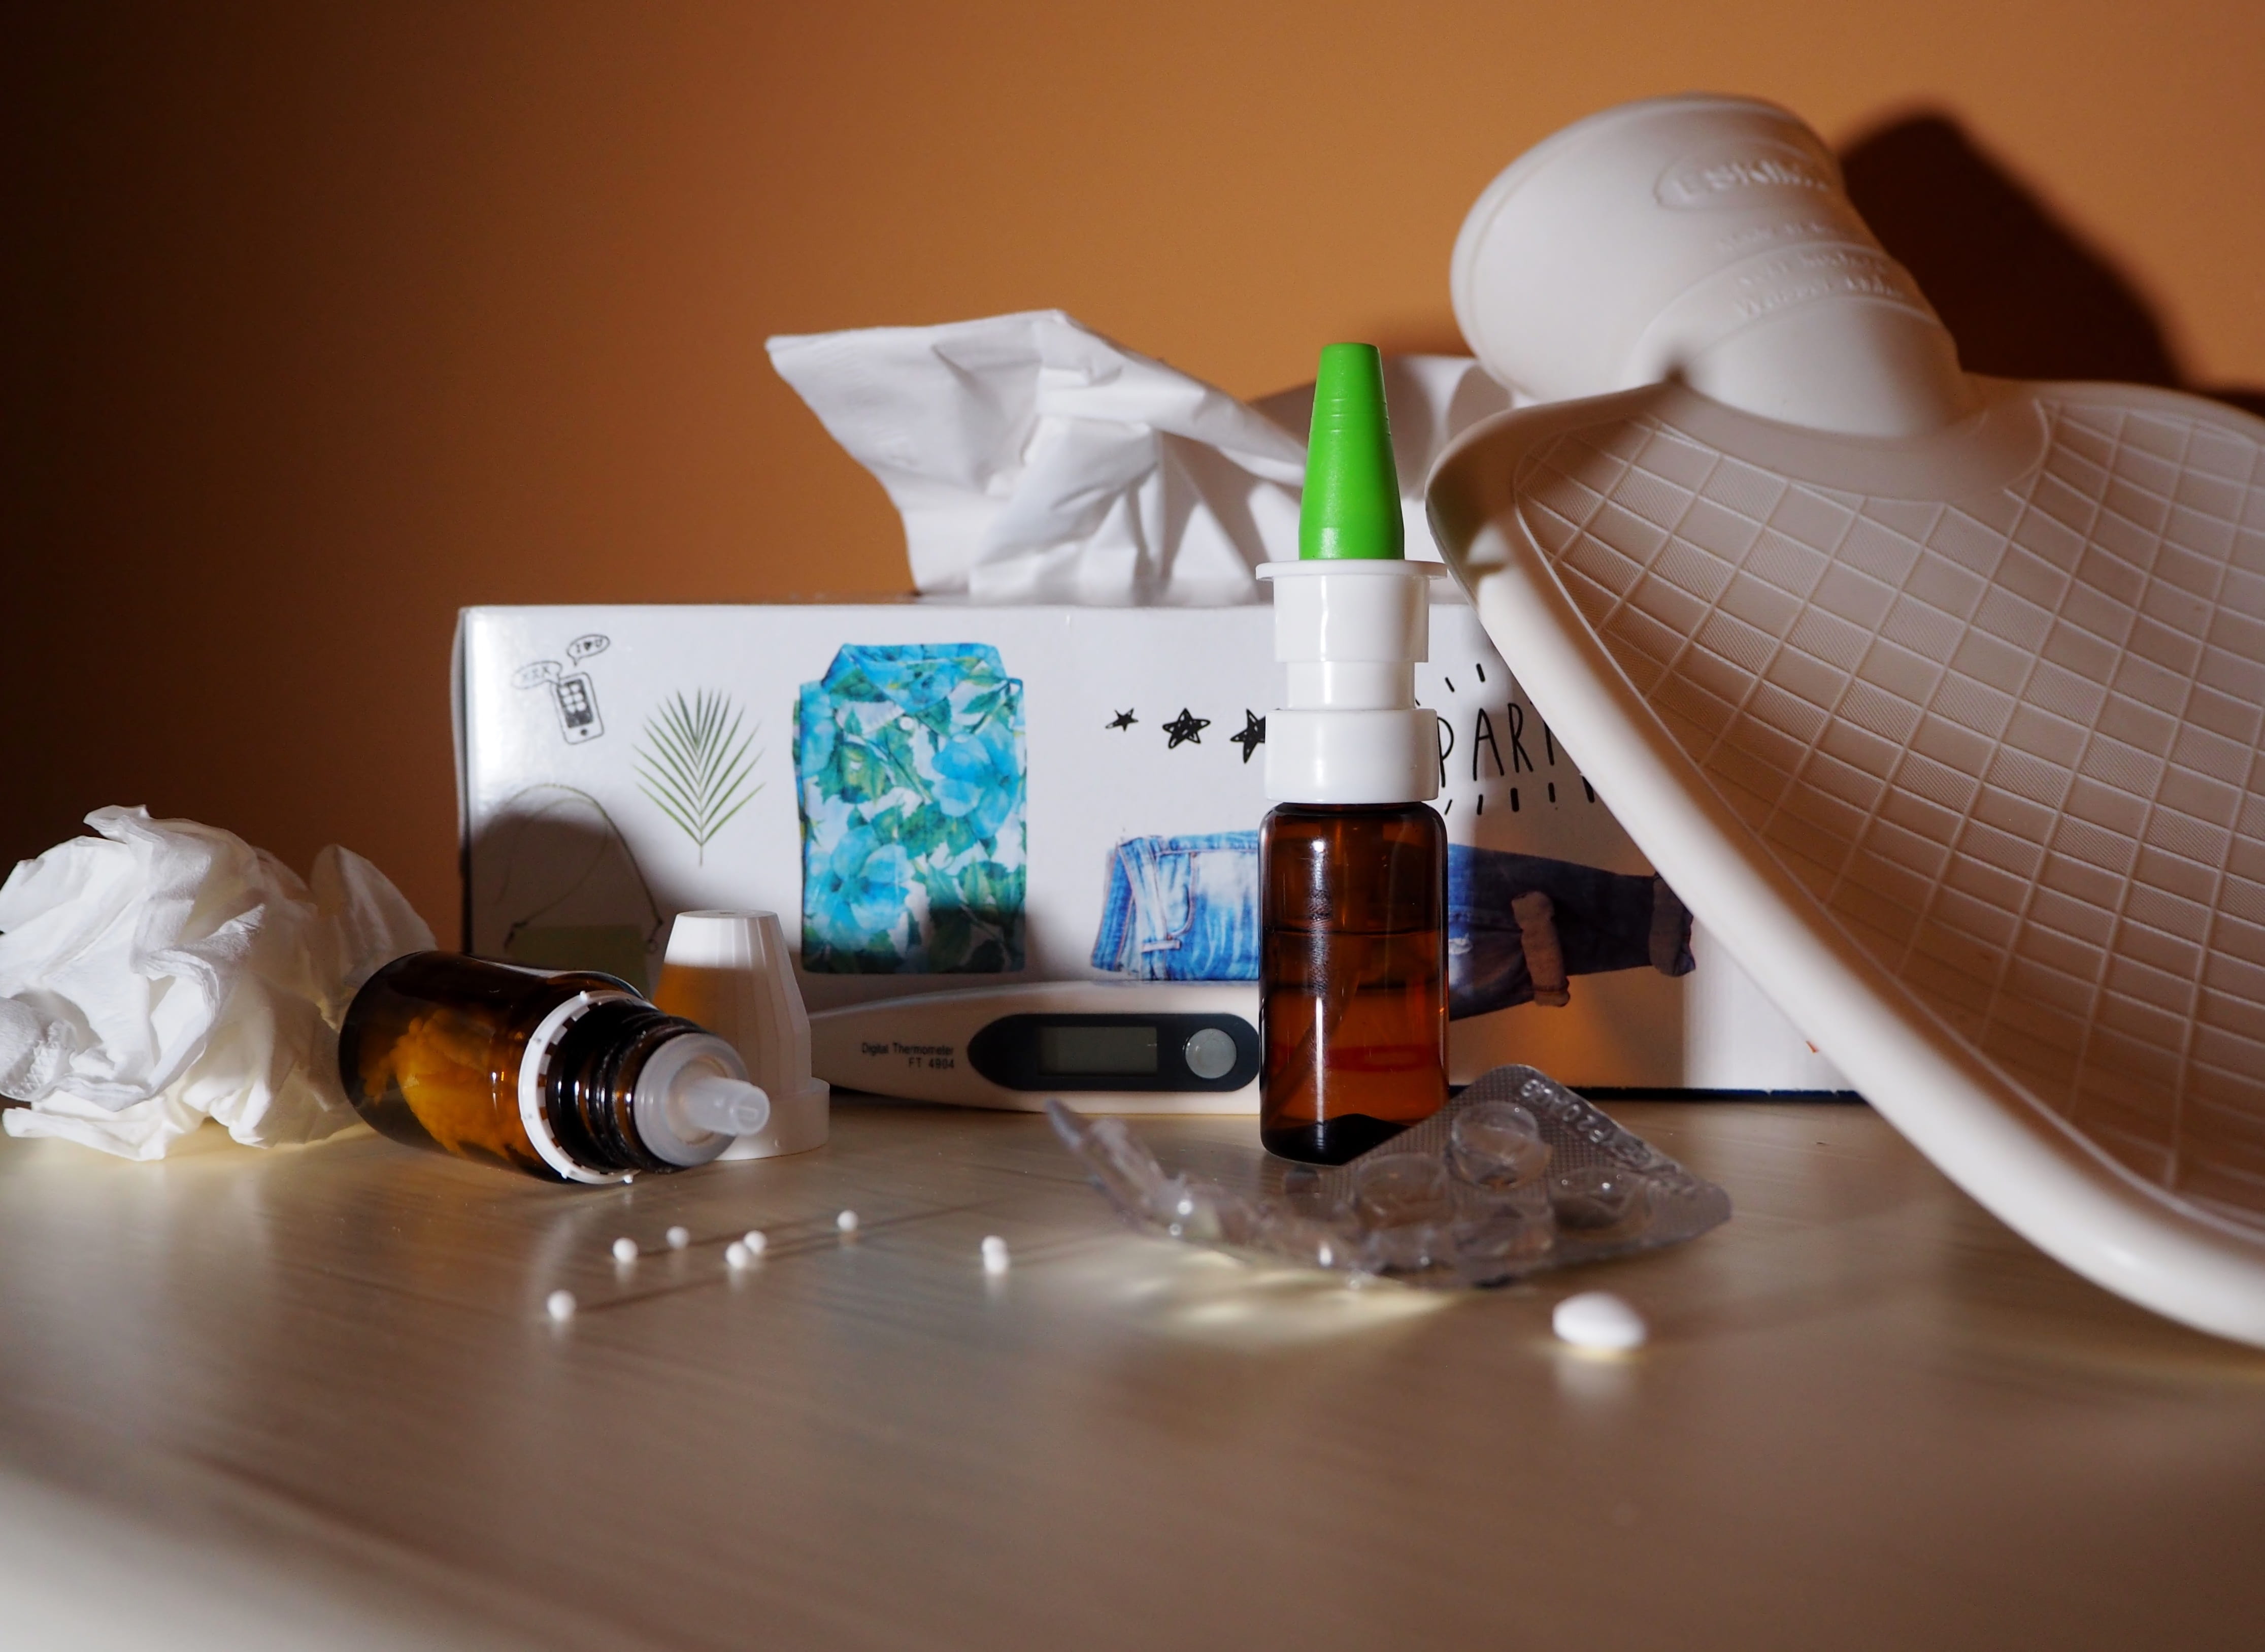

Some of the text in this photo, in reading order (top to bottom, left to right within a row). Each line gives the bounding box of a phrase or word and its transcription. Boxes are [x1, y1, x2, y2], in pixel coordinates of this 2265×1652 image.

[862, 1042, 954, 1056] Digital Thermometer
[909, 1057, 922, 1068] FT
